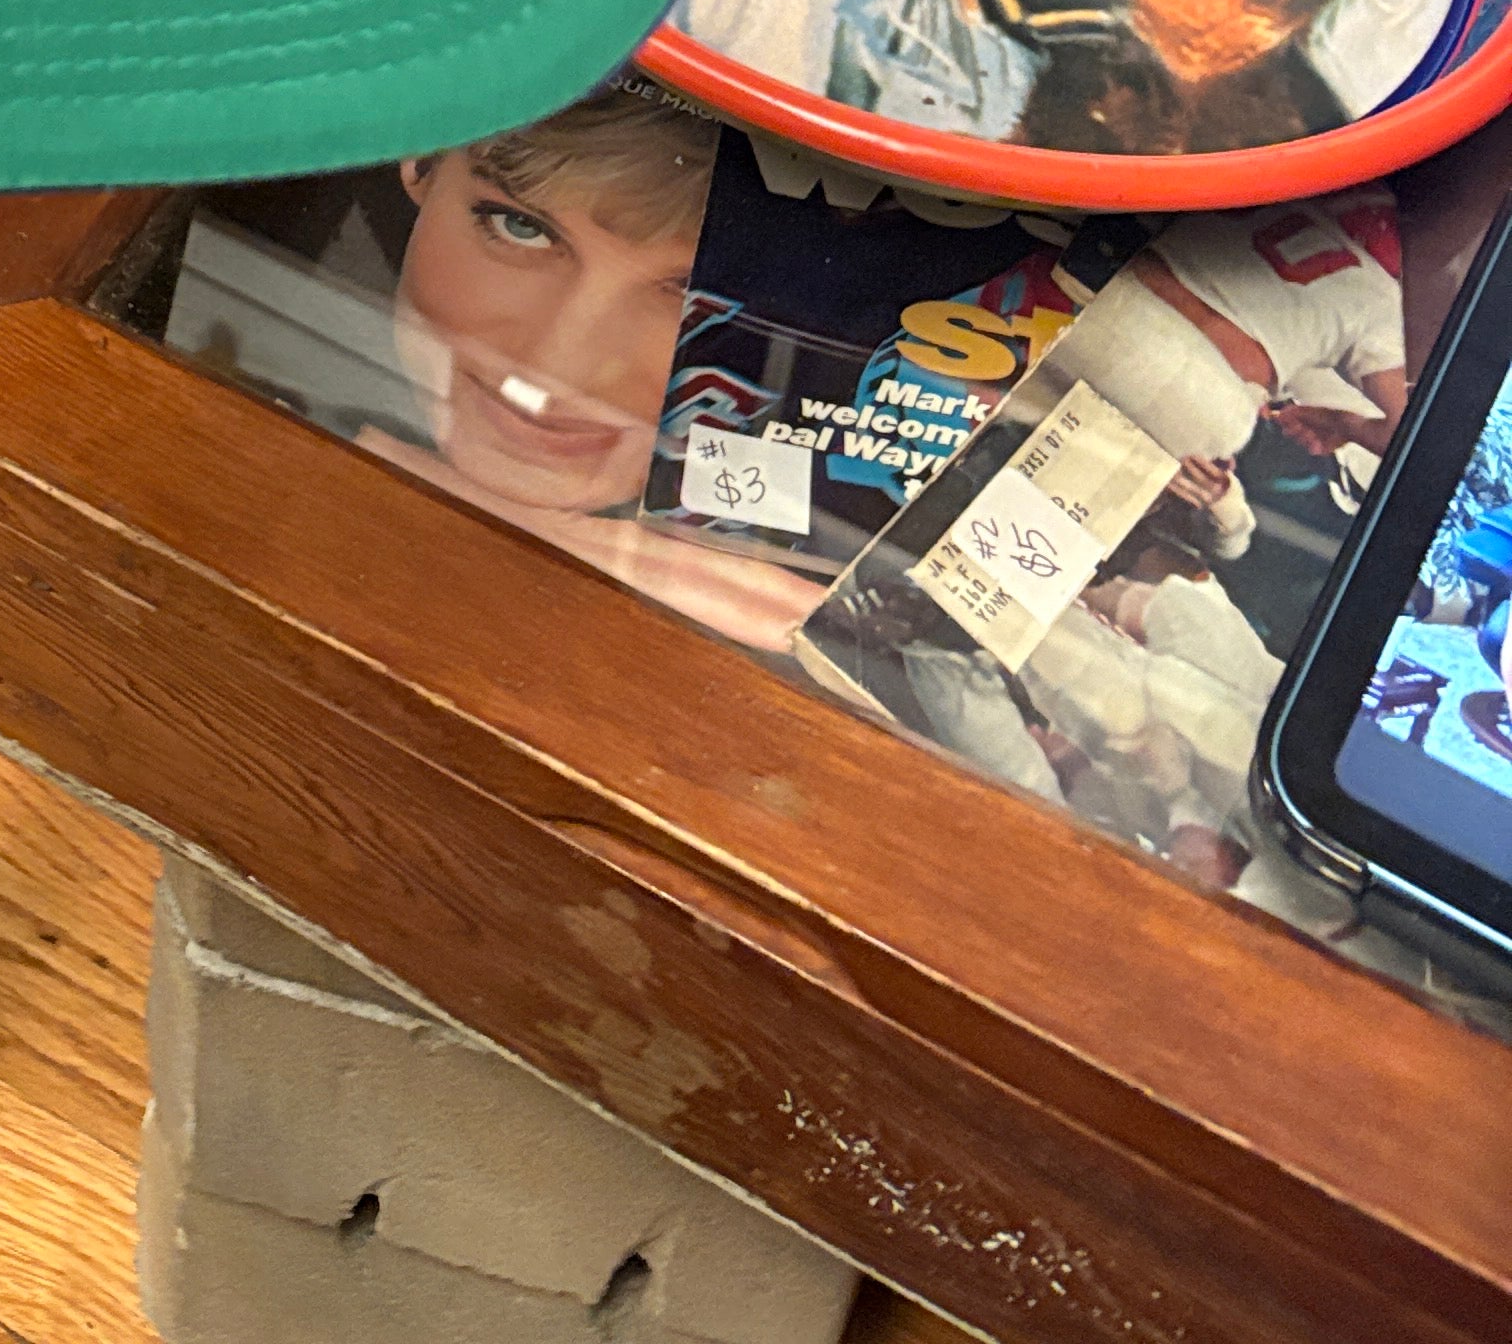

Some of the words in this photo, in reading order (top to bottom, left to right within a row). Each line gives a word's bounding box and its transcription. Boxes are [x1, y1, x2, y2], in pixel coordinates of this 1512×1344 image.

[875, 379, 992, 422] Mark
[761, 419, 833, 453] pal
[713, 465, 768, 509] $3
[970, 516, 1000, 560] #2
[1009, 521, 1064, 578] $5
